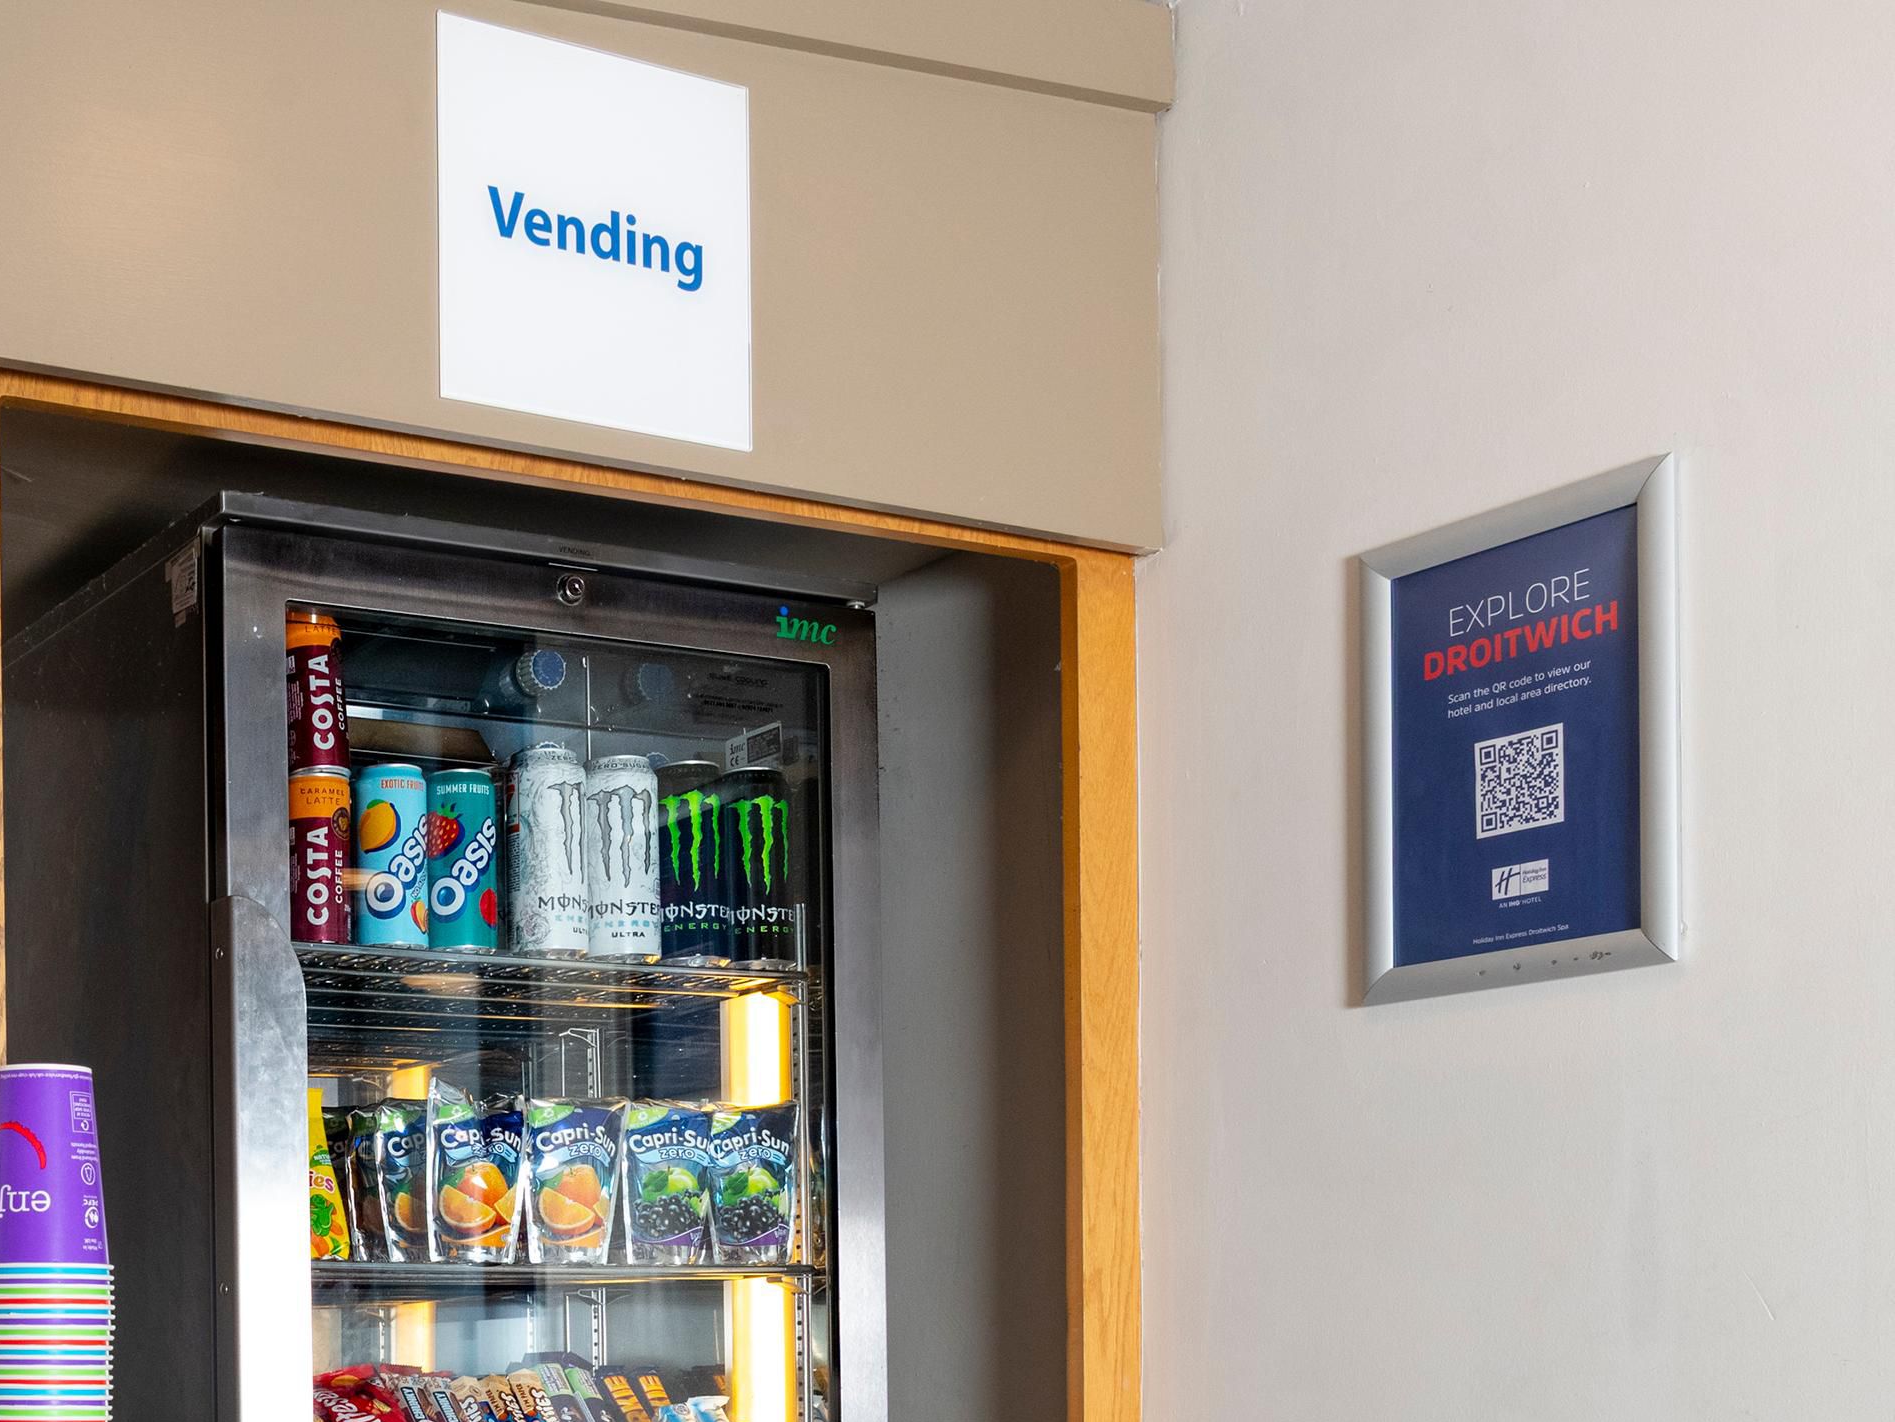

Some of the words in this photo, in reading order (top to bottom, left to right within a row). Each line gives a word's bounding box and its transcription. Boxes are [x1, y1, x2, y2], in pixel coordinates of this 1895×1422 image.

[487, 185, 703, 291] Vending
[1448, 568, 1591, 637] EXPLORE
[775, 606, 837, 645] imc
[1423, 600, 1618, 681] DROITWICH
[1448, 692, 1471, 705] Scan
[1473, 686, 1490, 699] the
[1492, 682, 1507, 694] QR
[1509, 676, 1533, 690] code
[1535, 673, 1545, 682] to
[1548, 665, 1571, 678] view
[1573, 660, 1592, 672] our
[1448, 704, 1472, 719] hotel
[1474, 700, 1494, 712] and
[1496, 693, 1518, 707] local
[1520, 689, 1542, 701] area
[1544, 676, 1592, 694] directory.
[308, 654, 336, 751] COSTA
[338, 678, 347, 731] COFFEE
[300, 787, 345, 798] CARAMEL
[306, 796, 341, 806] LATTE
[381, 779, 405, 790] EXOTIC
[436, 783, 468, 796] SUMMER
[469, 784, 490, 796] FRUITS
[307, 826, 330, 927] COSTA
[334, 849, 344, 904] COFFEE
[431, 816, 497, 916] Oasis
[1522, 896, 1542, 905] HOTEL
[664, 922, 727, 932] ENERGY
[440, 1127, 522, 1152] Capi-Sun
[536, 1122, 616, 1157] Capri-Sun
[569, 1143, 602, 1157] zero
[659, 1148, 695, 1160] zero
[710, 1127, 790, 1160] Capri-Sun
[740, 1147, 771, 1160] zero
[401, 1388, 426, 1420] CHUNKY
[435, 1393, 459, 1422] CHUNKY
